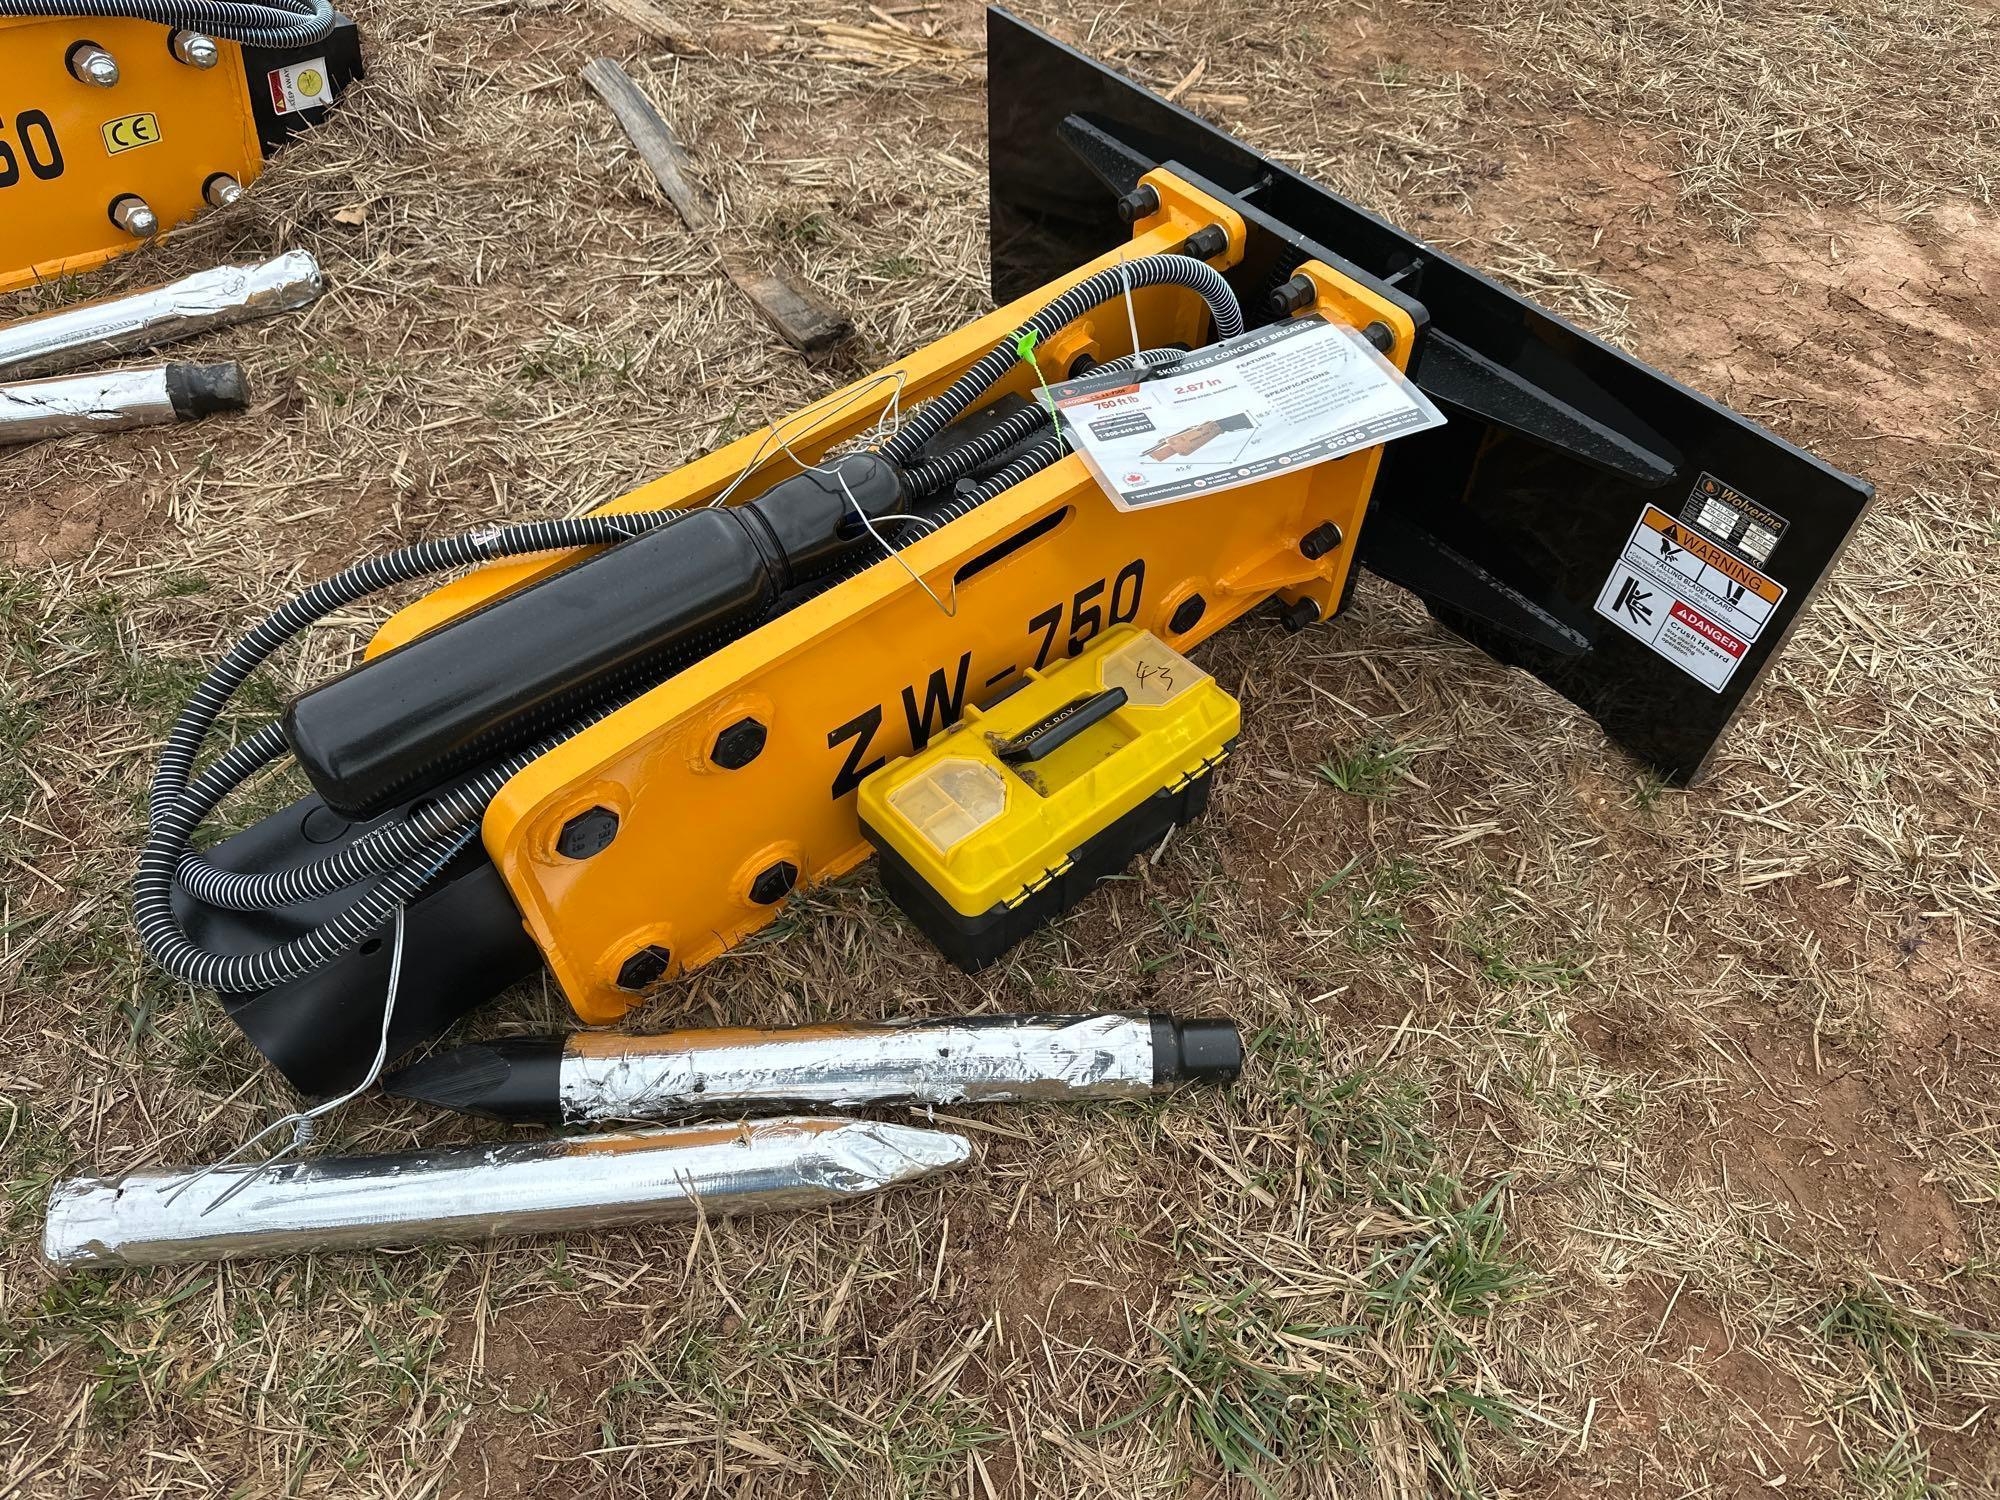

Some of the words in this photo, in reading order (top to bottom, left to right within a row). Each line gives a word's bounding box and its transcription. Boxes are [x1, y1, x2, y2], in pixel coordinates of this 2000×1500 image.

[111, 116, 149, 147] CE
[1156, 365, 1181, 377] SKID
[1184, 357, 1213, 371] STEER
[1215, 336, 1269, 361] CONCRETE
[1269, 319, 1317, 341] BREAKER
[1236, 352, 1277, 369] FEATURES
[1174, 382, 1205, 395] 2.67
[1264, 370, 1331, 398] SPECIFICATIONS
[1095, 400, 1117, 411] 750
[1721, 489, 1782, 530] Wolverine
[1682, 534, 1762, 590] WARNING
[1655, 560, 1682, 580] FALLING
[1683, 578, 1705, 594] BLADE
[1705, 592, 1732, 612] HAZARD
[1661, 636, 1688, 657] operation.
[1663, 632, 1676, 642] area
[1676, 641, 1695, 655] during
[1666, 628, 1677, 637] Stay
[1670, 621, 1696, 641] Crush
[1697, 639, 1729, 663] Hazard
[1687, 614, 1738, 650] DANGER
[1135, 660, 1174, 692] 43
